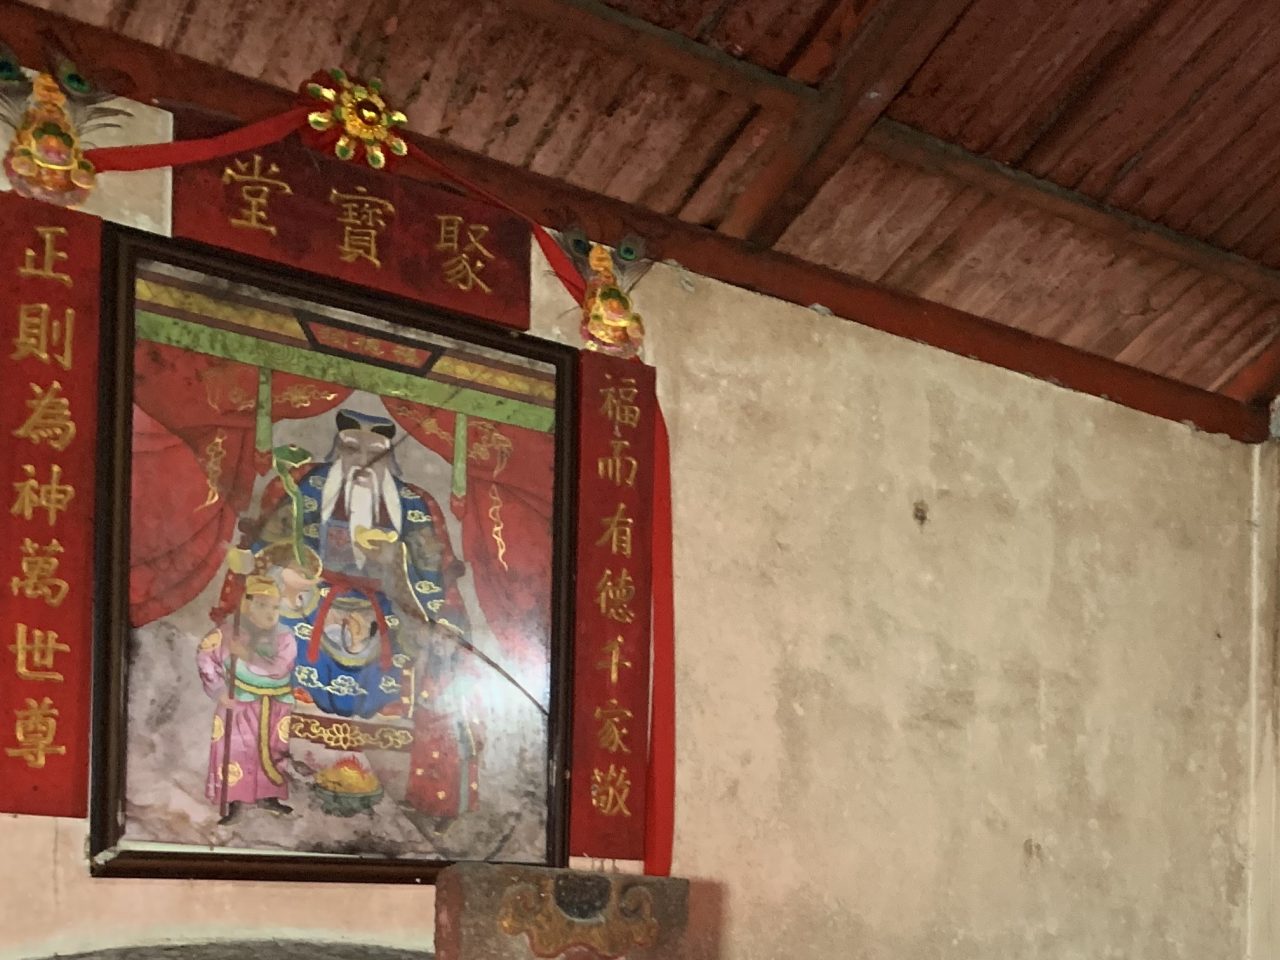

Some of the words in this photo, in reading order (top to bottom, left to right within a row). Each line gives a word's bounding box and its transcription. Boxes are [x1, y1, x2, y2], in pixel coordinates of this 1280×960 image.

[221, 153, 496, 295] 聚寶堂
[5, 225, 77, 769] 正則為神萬世尊
